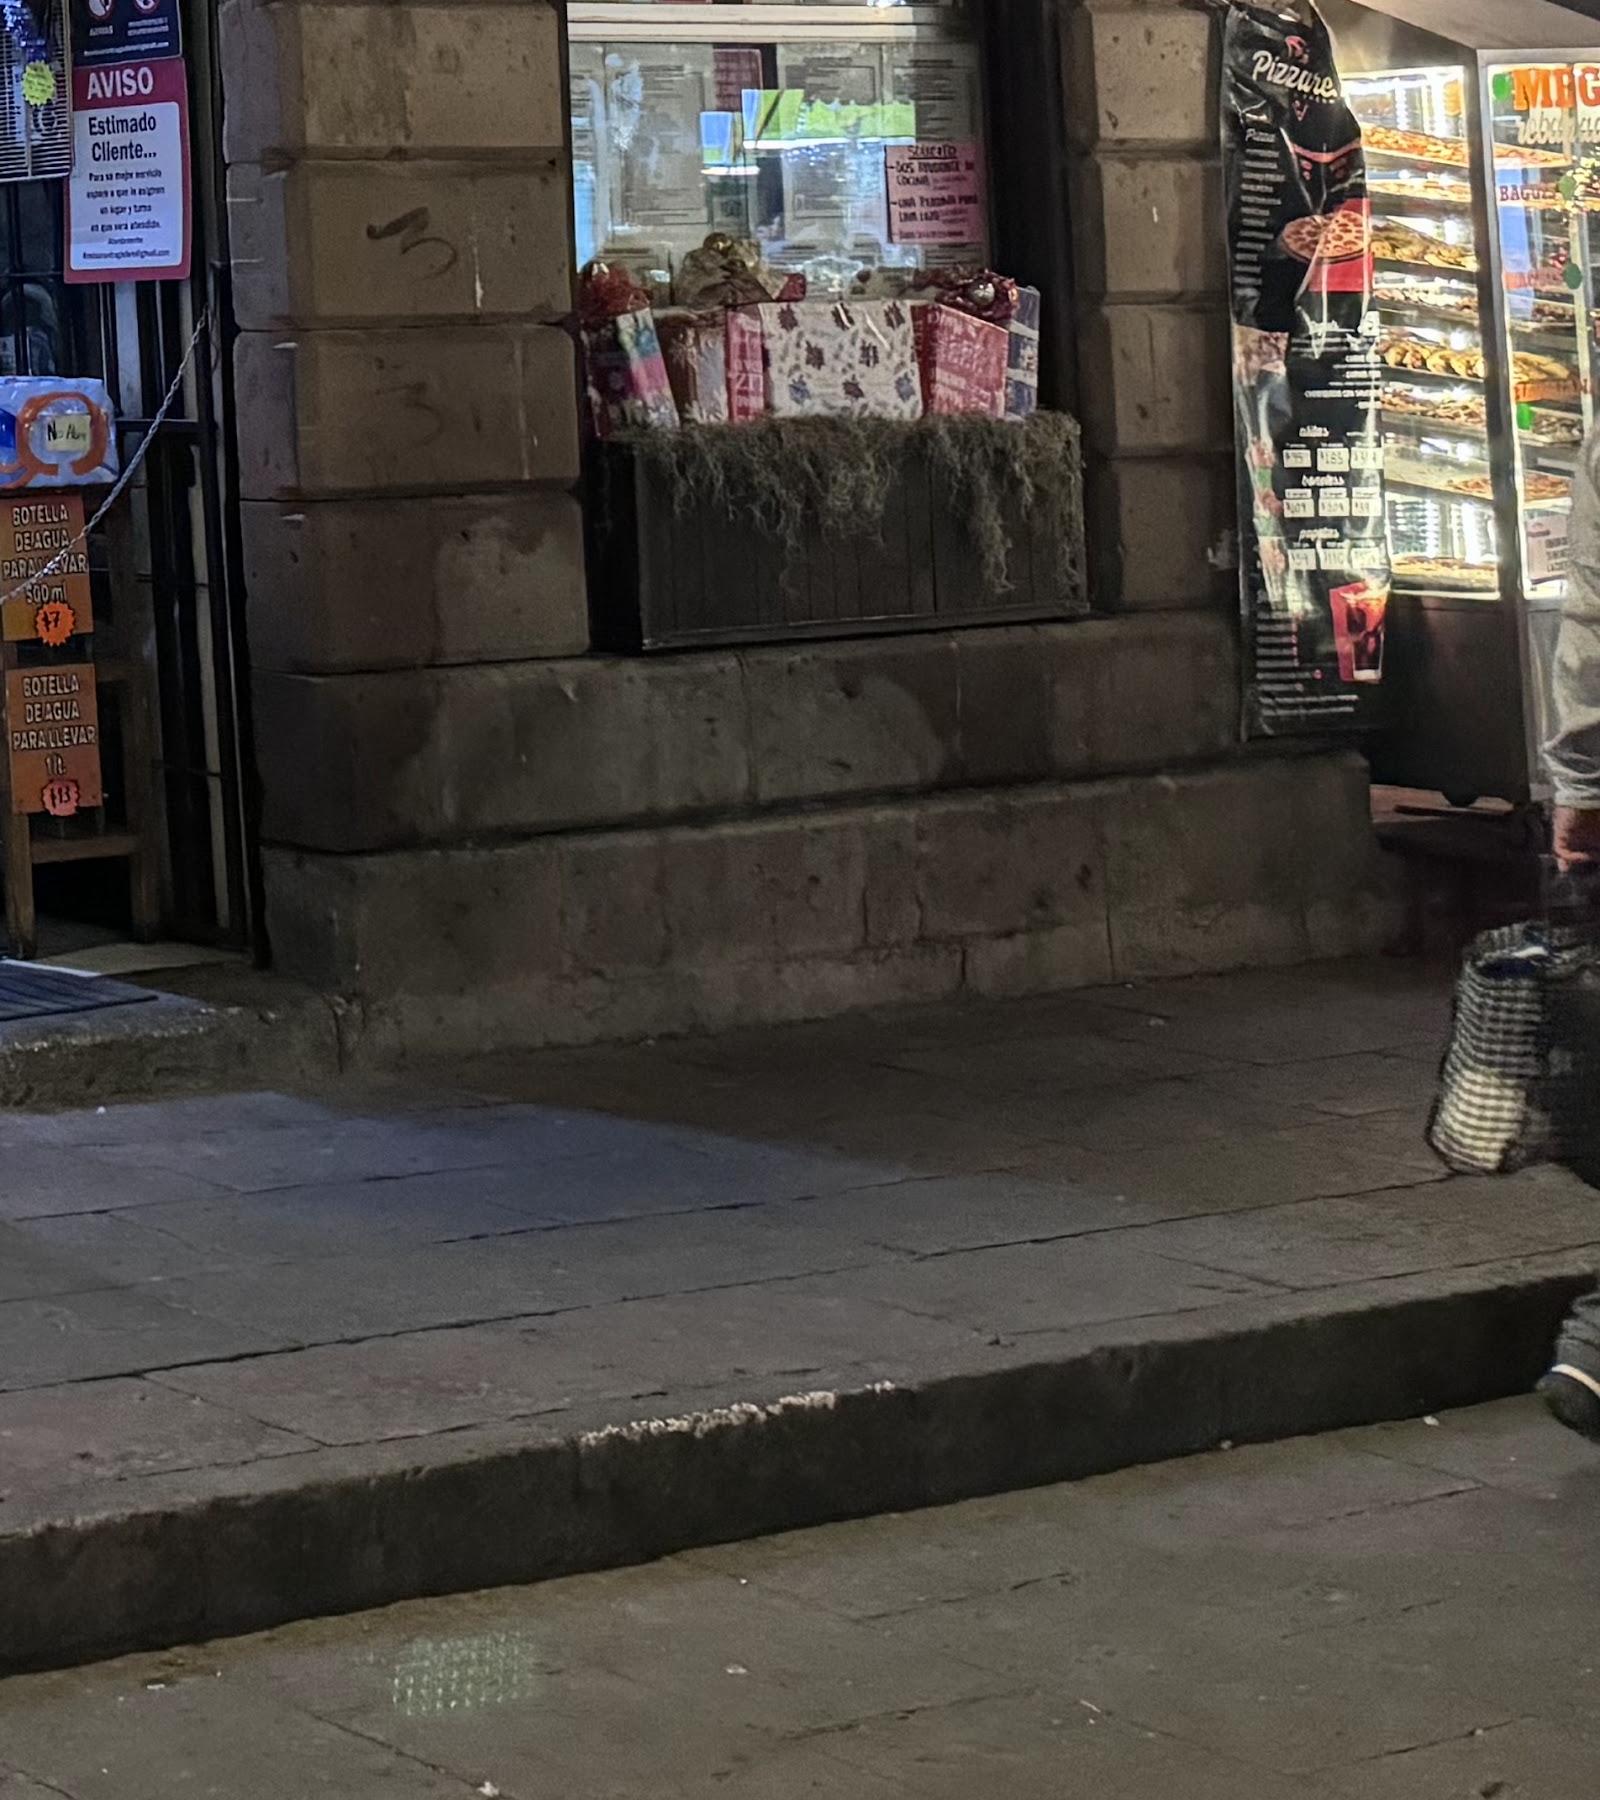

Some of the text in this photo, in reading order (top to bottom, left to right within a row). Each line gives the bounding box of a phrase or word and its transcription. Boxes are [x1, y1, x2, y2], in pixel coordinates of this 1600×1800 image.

[87, 66, 153, 100] AVISO
[88, 111, 157, 136] Estimado
[13, 504, 68, 526] BOTELLA
[15, 530, 70, 552] DE AGUA
[3, 559, 36, 579] PARA
[23, 675, 79, 697] BOTELLA
[25, 701, 80, 723] DE AGUA
[13, 726, 96, 750] PARA LLEVAR
